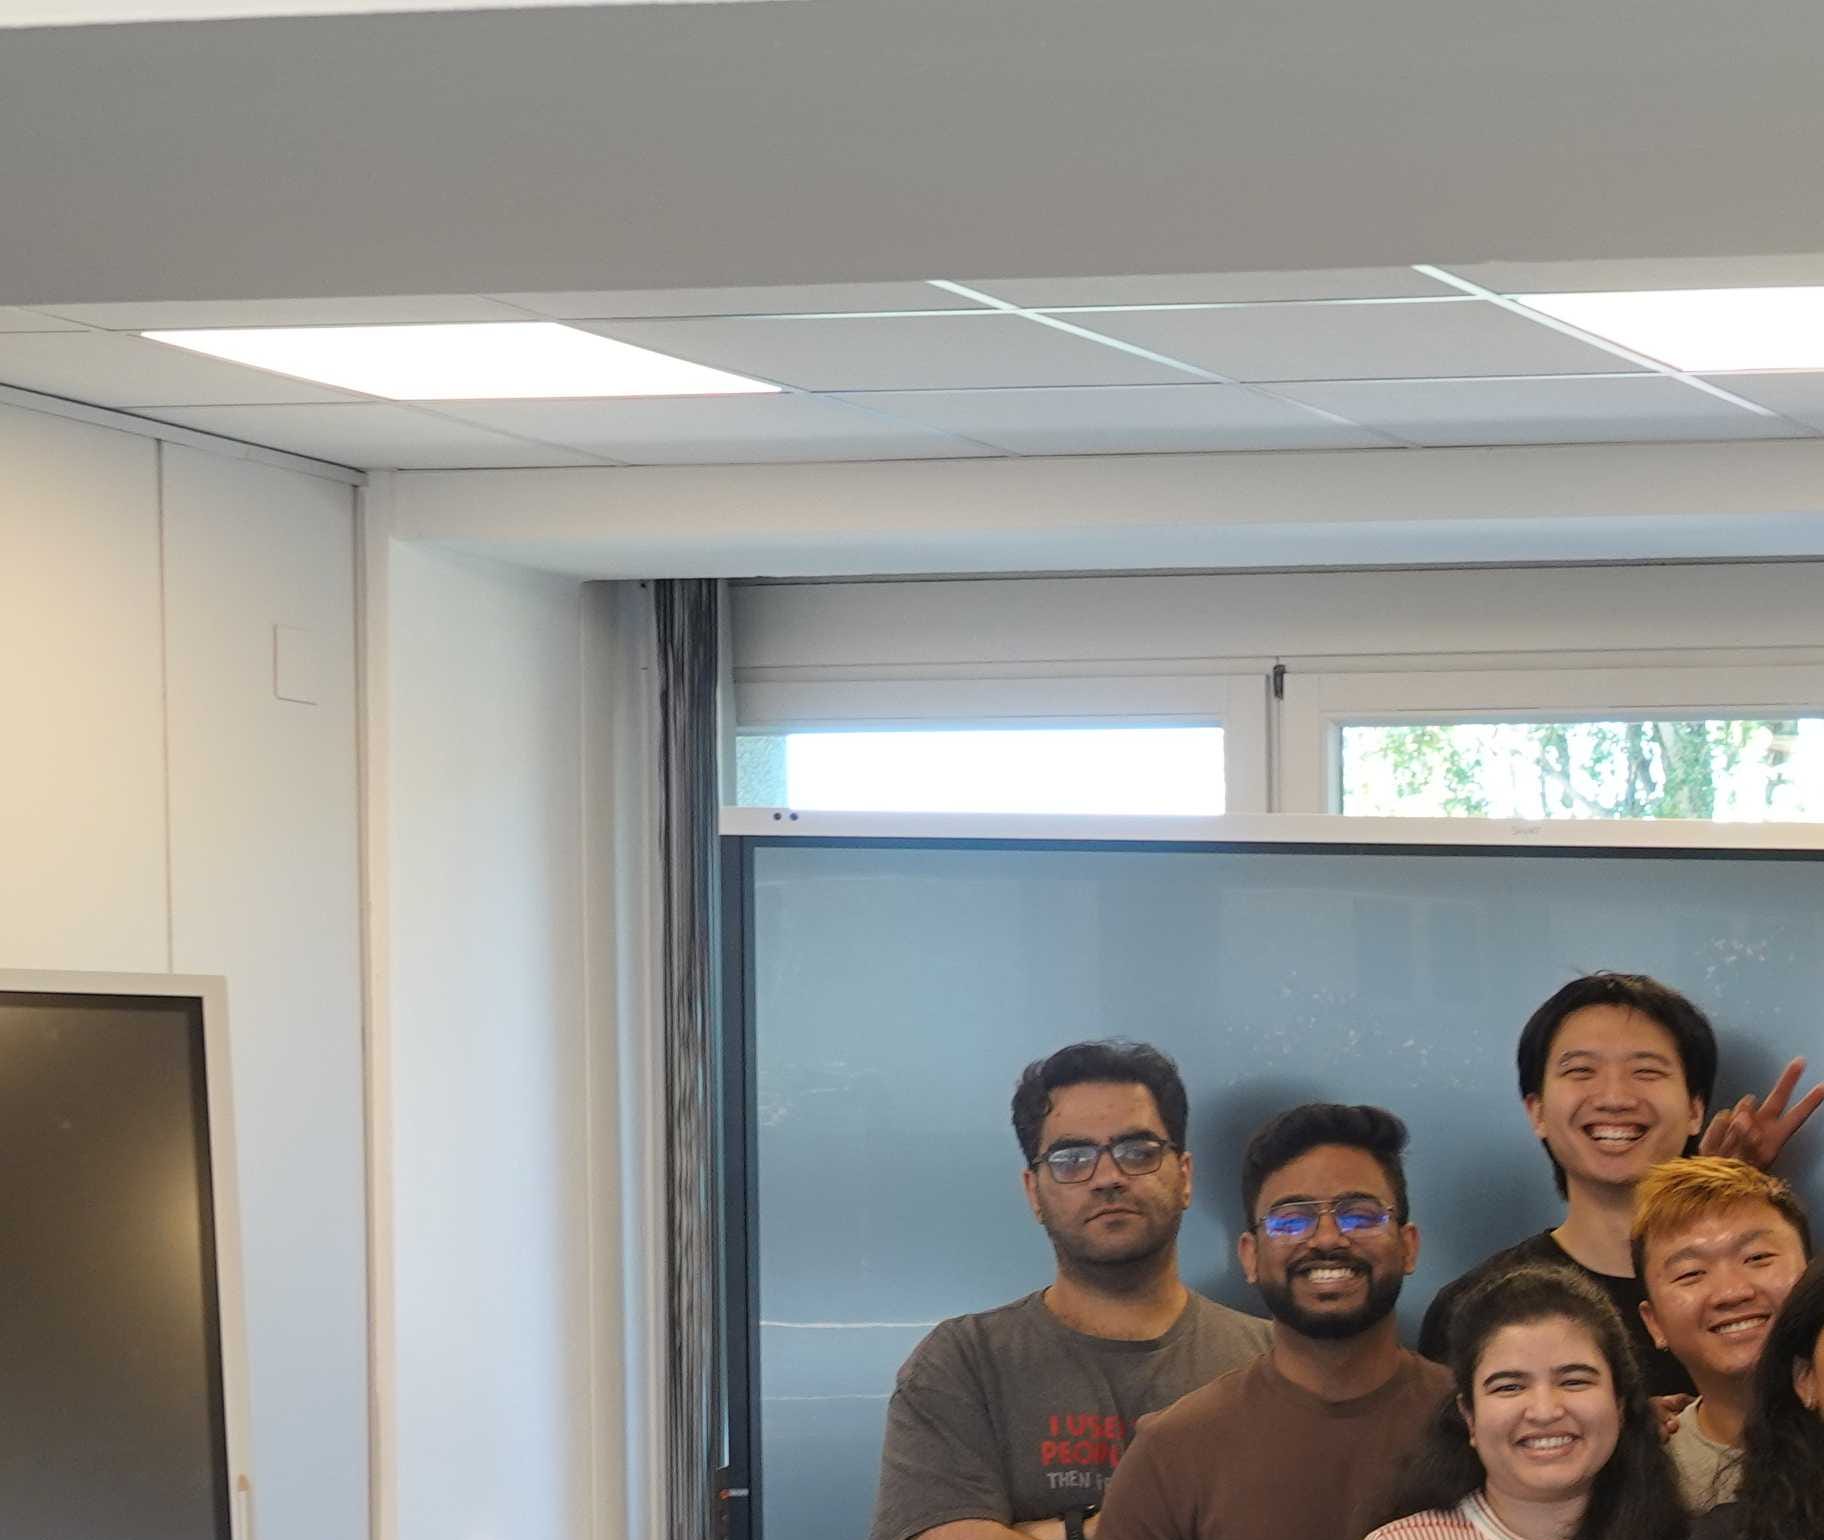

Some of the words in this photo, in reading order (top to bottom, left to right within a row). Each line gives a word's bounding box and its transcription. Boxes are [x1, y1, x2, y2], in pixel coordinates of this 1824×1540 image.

[1048, 1414, 1060, 1437] I
[1041, 1440, 1121, 1469] PEOPL
[1046, 1470, 1092, 1489] THEN
